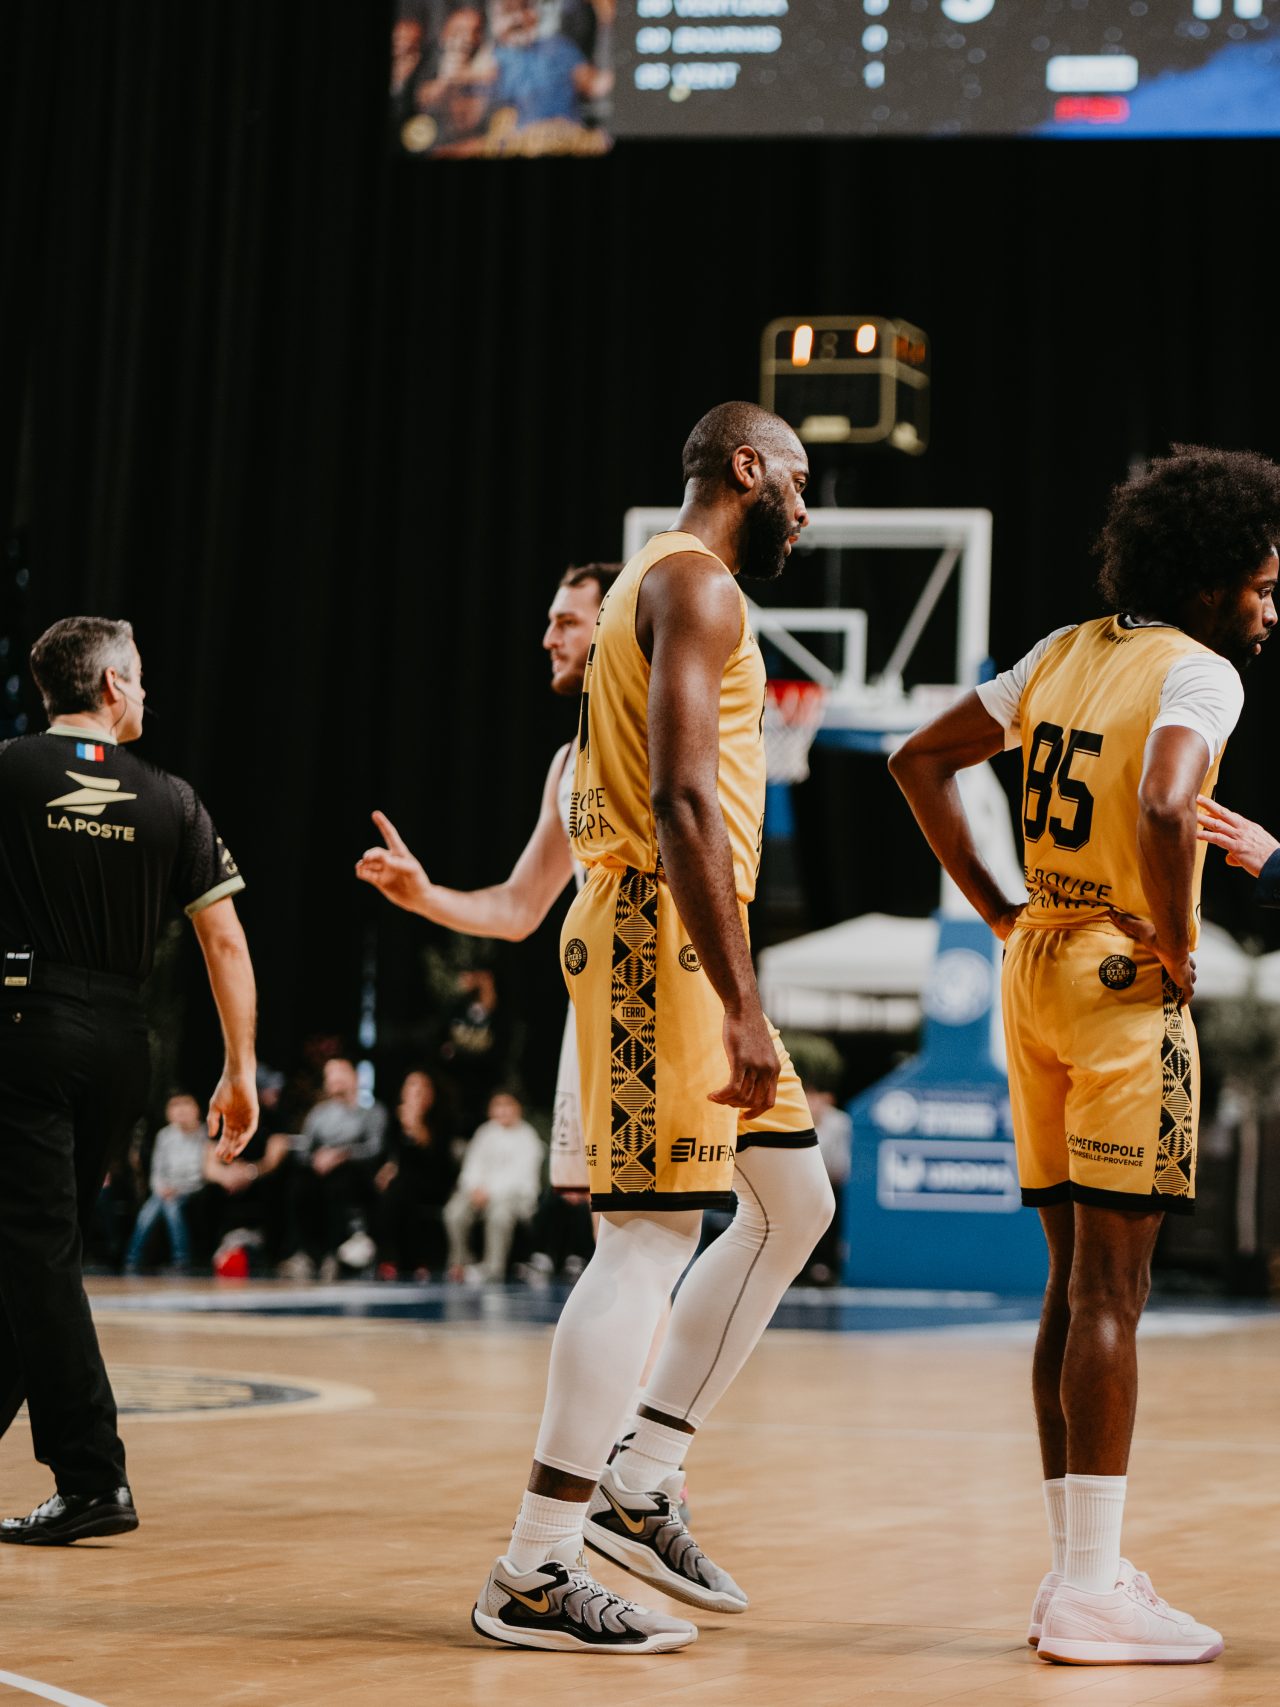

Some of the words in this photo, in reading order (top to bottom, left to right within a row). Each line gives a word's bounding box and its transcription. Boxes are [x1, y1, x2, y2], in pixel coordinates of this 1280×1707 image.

[1023, 720, 1104, 852] 85
[47, 813, 72, 831] LA
[75, 818, 135, 841] POSTE
[621, 1006, 646, 1018] TERRO
